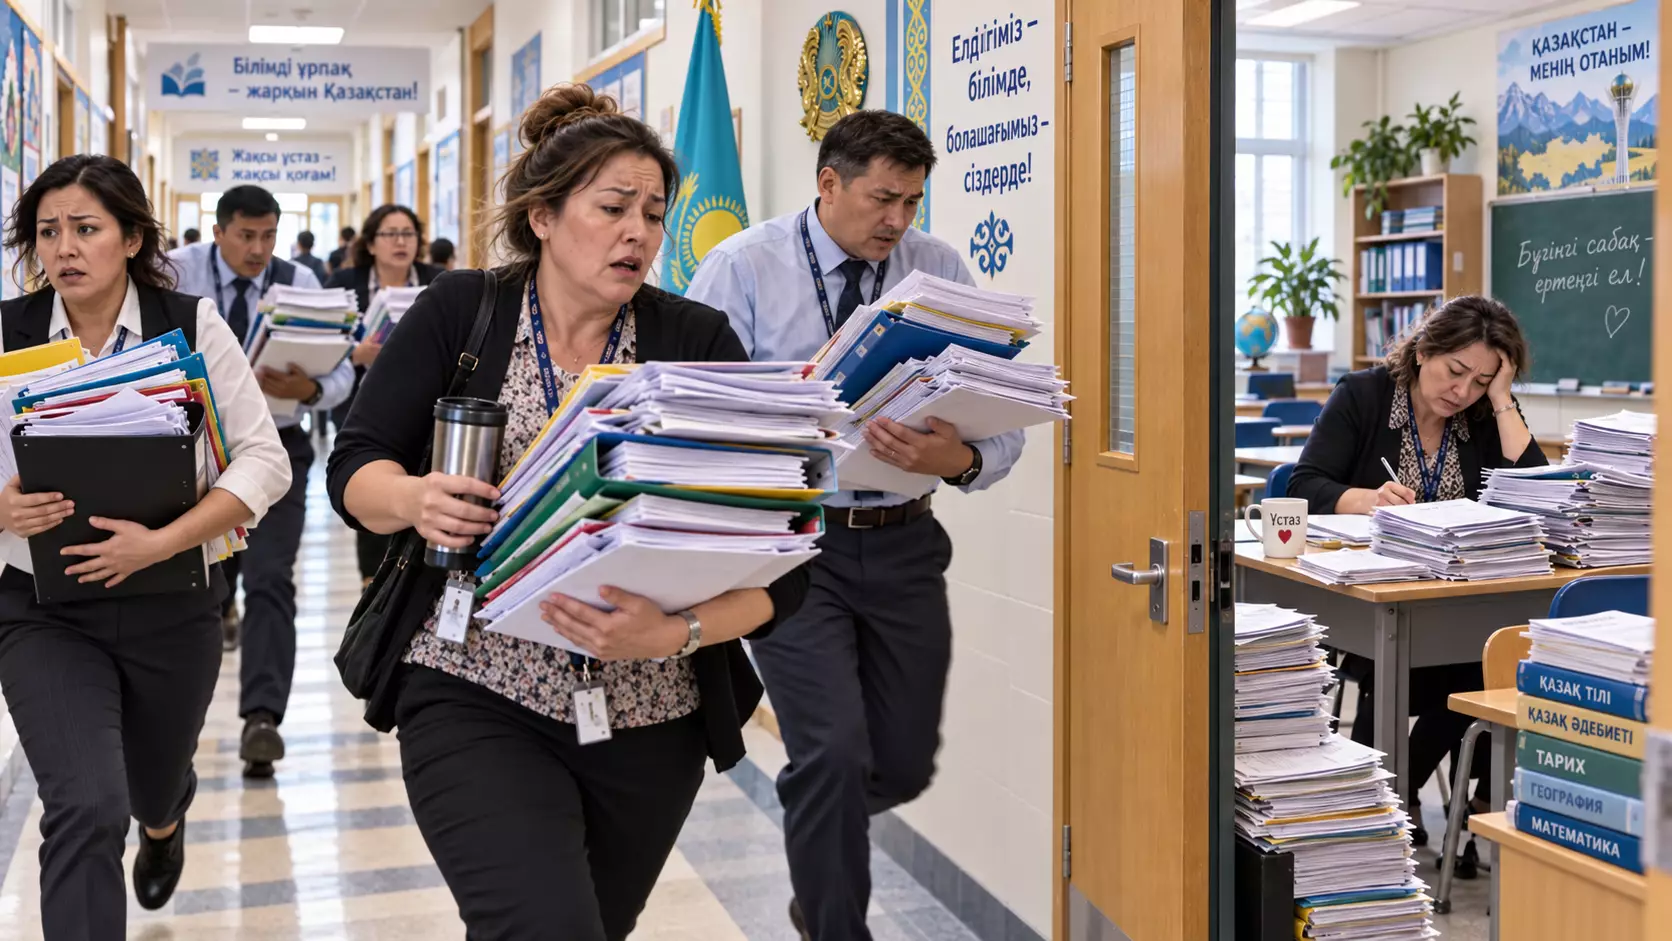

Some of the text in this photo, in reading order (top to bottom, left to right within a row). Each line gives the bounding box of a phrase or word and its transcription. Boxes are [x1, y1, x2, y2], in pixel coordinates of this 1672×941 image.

[1532, 21, 1618, 58] ҚАЗАҚСТАН
[233, 56, 292, 78] Білімді
[1530, 40, 1650, 82] МЕНІҢ ОТАНЫМ!
[246, 85, 318, 102] жарқын
[324, 81, 418, 102] Қазақстан!
[968, 65, 1031, 102] білімде,
[946, 114, 1038, 154] болашағымыз
[232, 149, 278, 164] Жақсы
[964, 152, 1032, 196] сіздерде!
[232, 169, 281, 183] жақсы
[1586, 226, 1640, 254] сабақ
[1535, 258, 1646, 304] ертеңгі ел!
[1539, 675, 1611, 705] ҚАЗАҚ ТІЛІ
[1527, 706, 1634, 745] ҚАЗАҚ ӘДЕБИЕТІ
[1535, 748, 1586, 775] ТАРИХ
[1530, 781, 1604, 814] ГЕОГРАФИЯ
[1531, 815, 1621, 859] МАТЕМАТИКА
